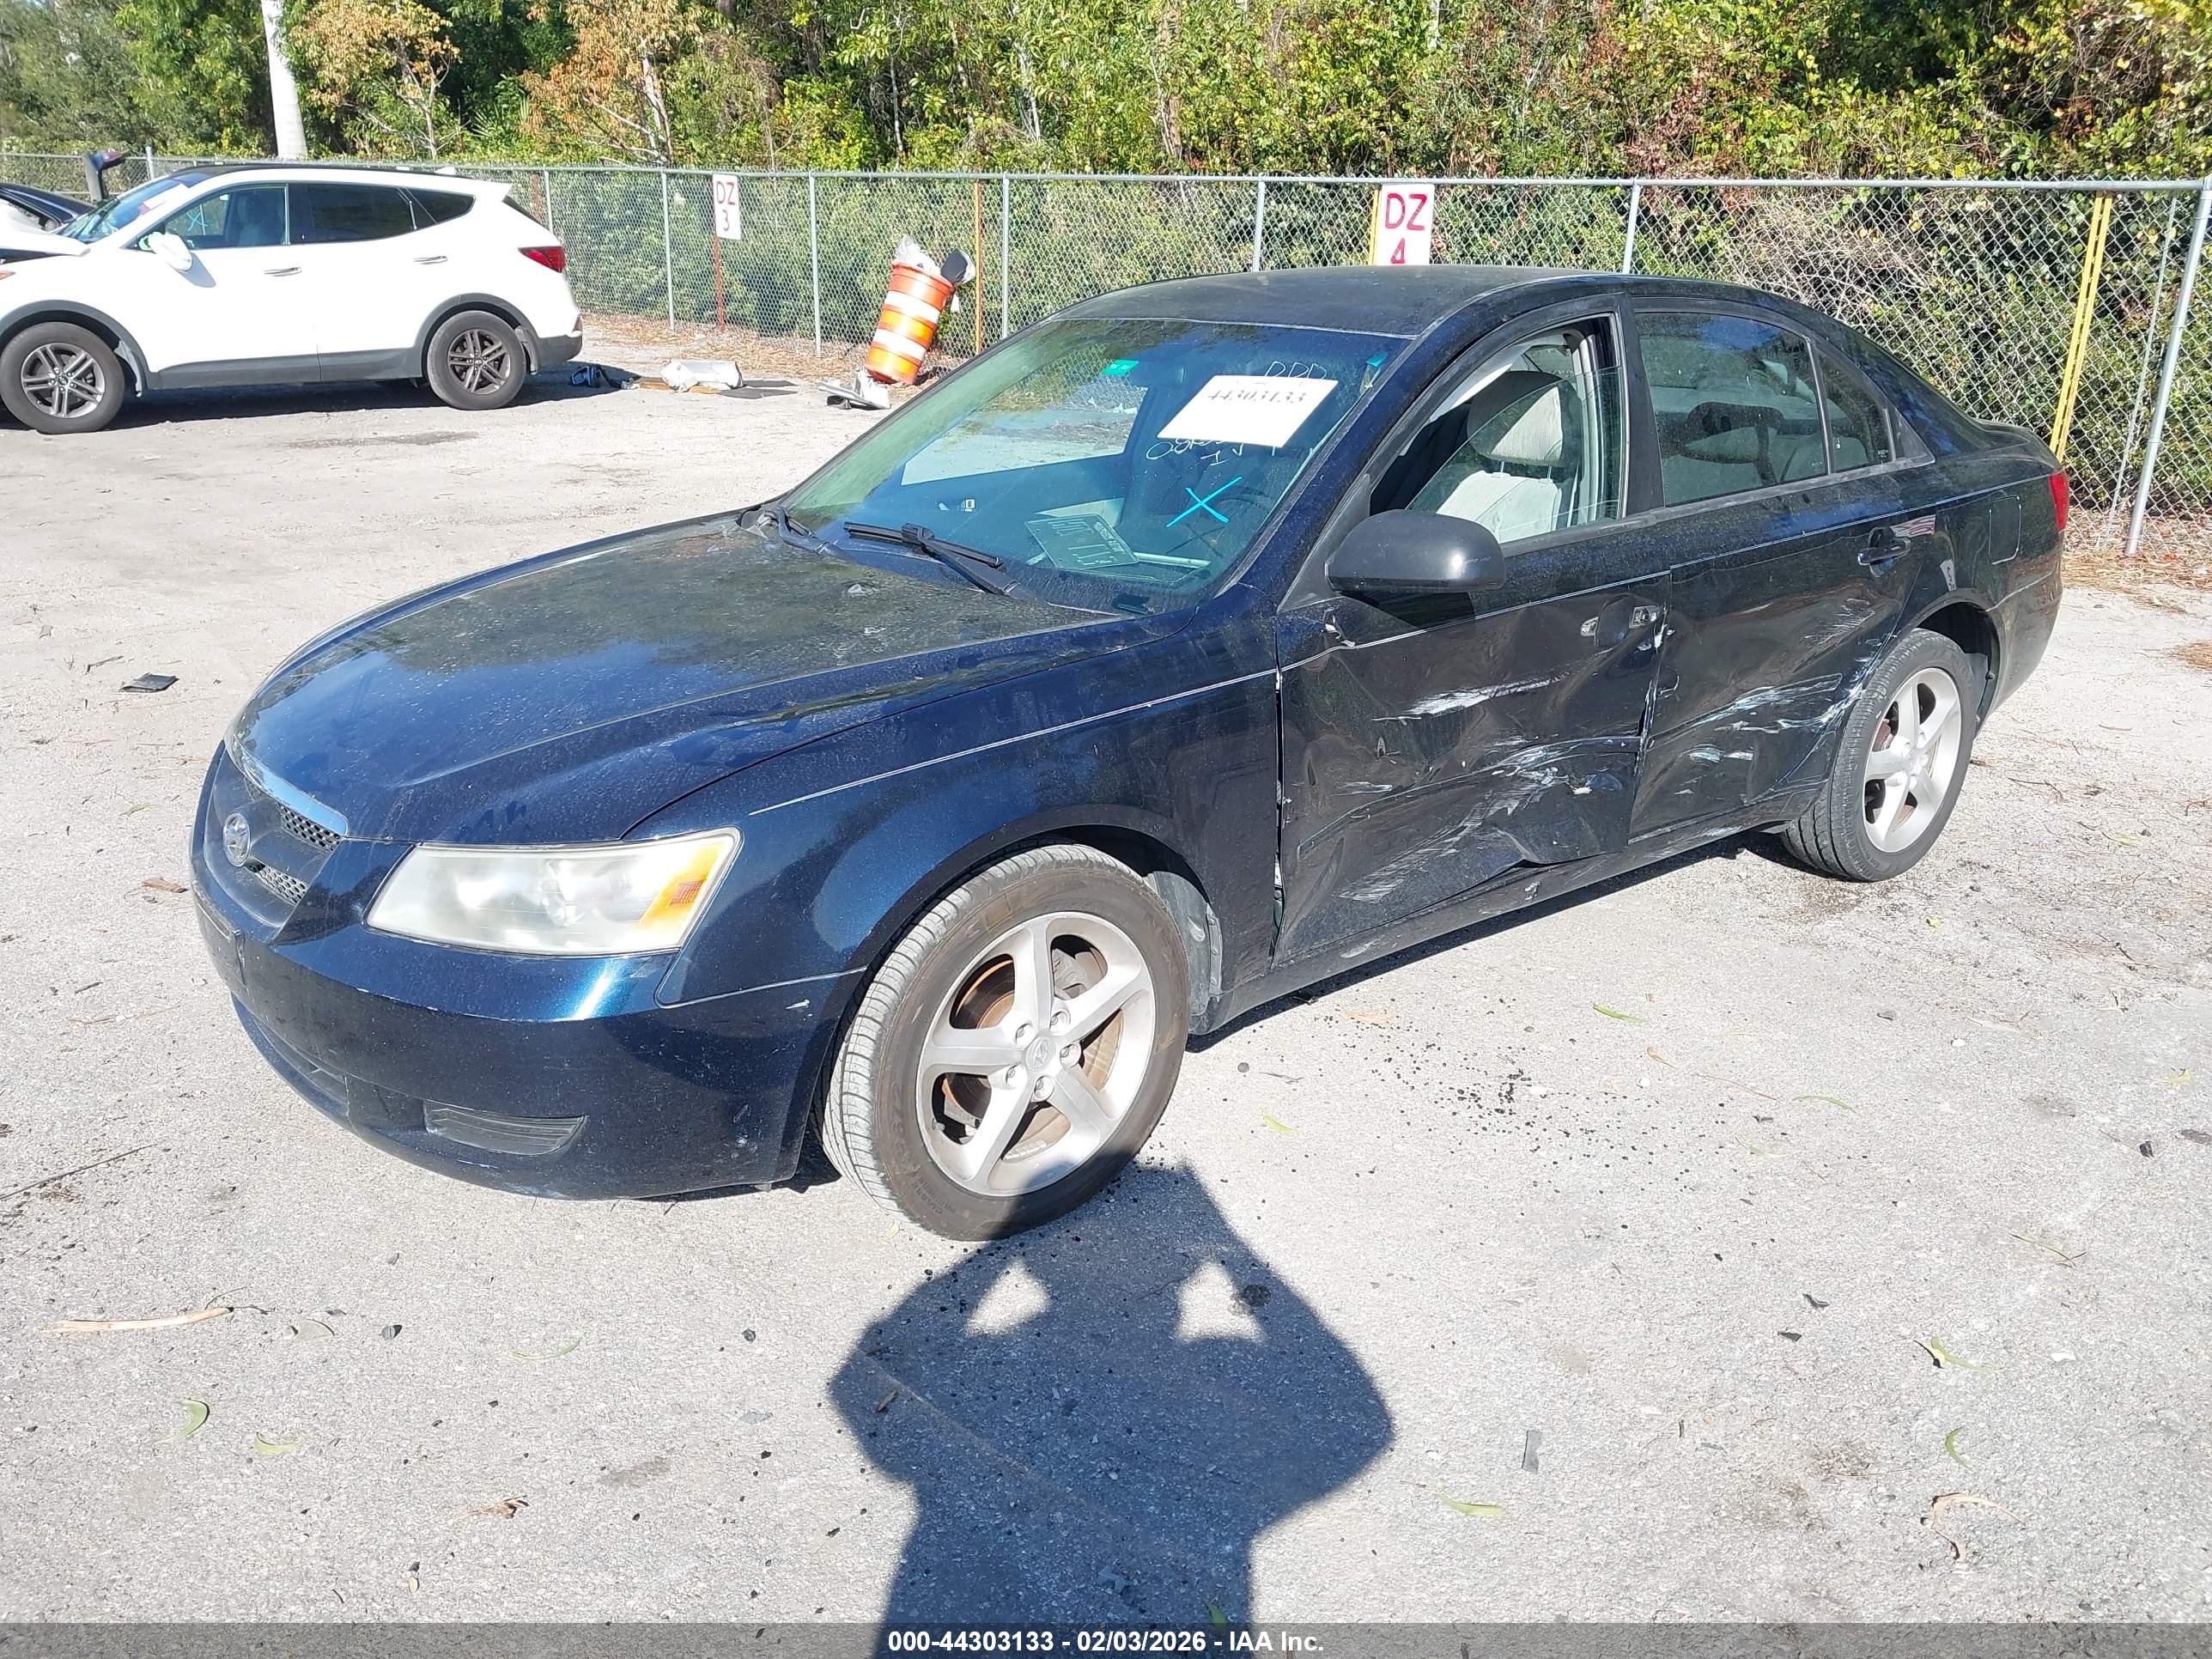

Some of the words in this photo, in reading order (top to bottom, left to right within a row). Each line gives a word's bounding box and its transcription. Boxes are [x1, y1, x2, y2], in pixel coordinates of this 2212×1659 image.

[715, 180, 736, 206] DZ
[721, 209, 731, 232] 3
[1384, 191, 1428, 231] DZ
[1389, 237, 1407, 264] 4
